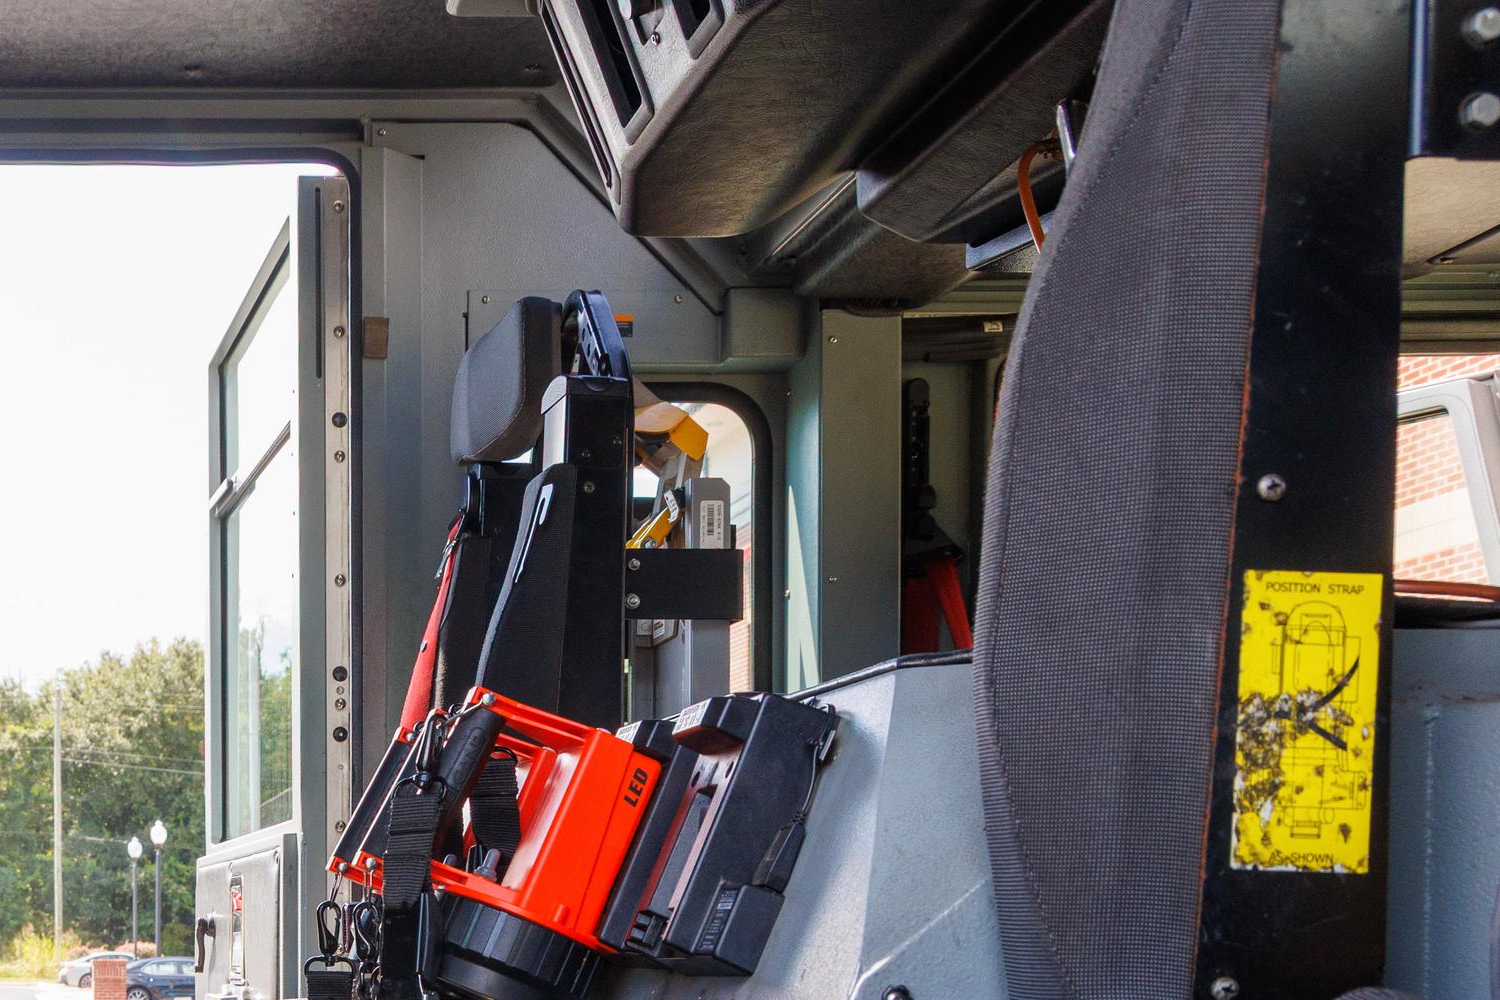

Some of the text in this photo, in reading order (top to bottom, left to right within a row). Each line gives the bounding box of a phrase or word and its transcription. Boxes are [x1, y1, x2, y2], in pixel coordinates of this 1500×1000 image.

[1266, 582, 1365, 595] POSITION STRAP
[624, 768, 648, 807] LED
[1290, 851, 1334, 865] SHOWN
